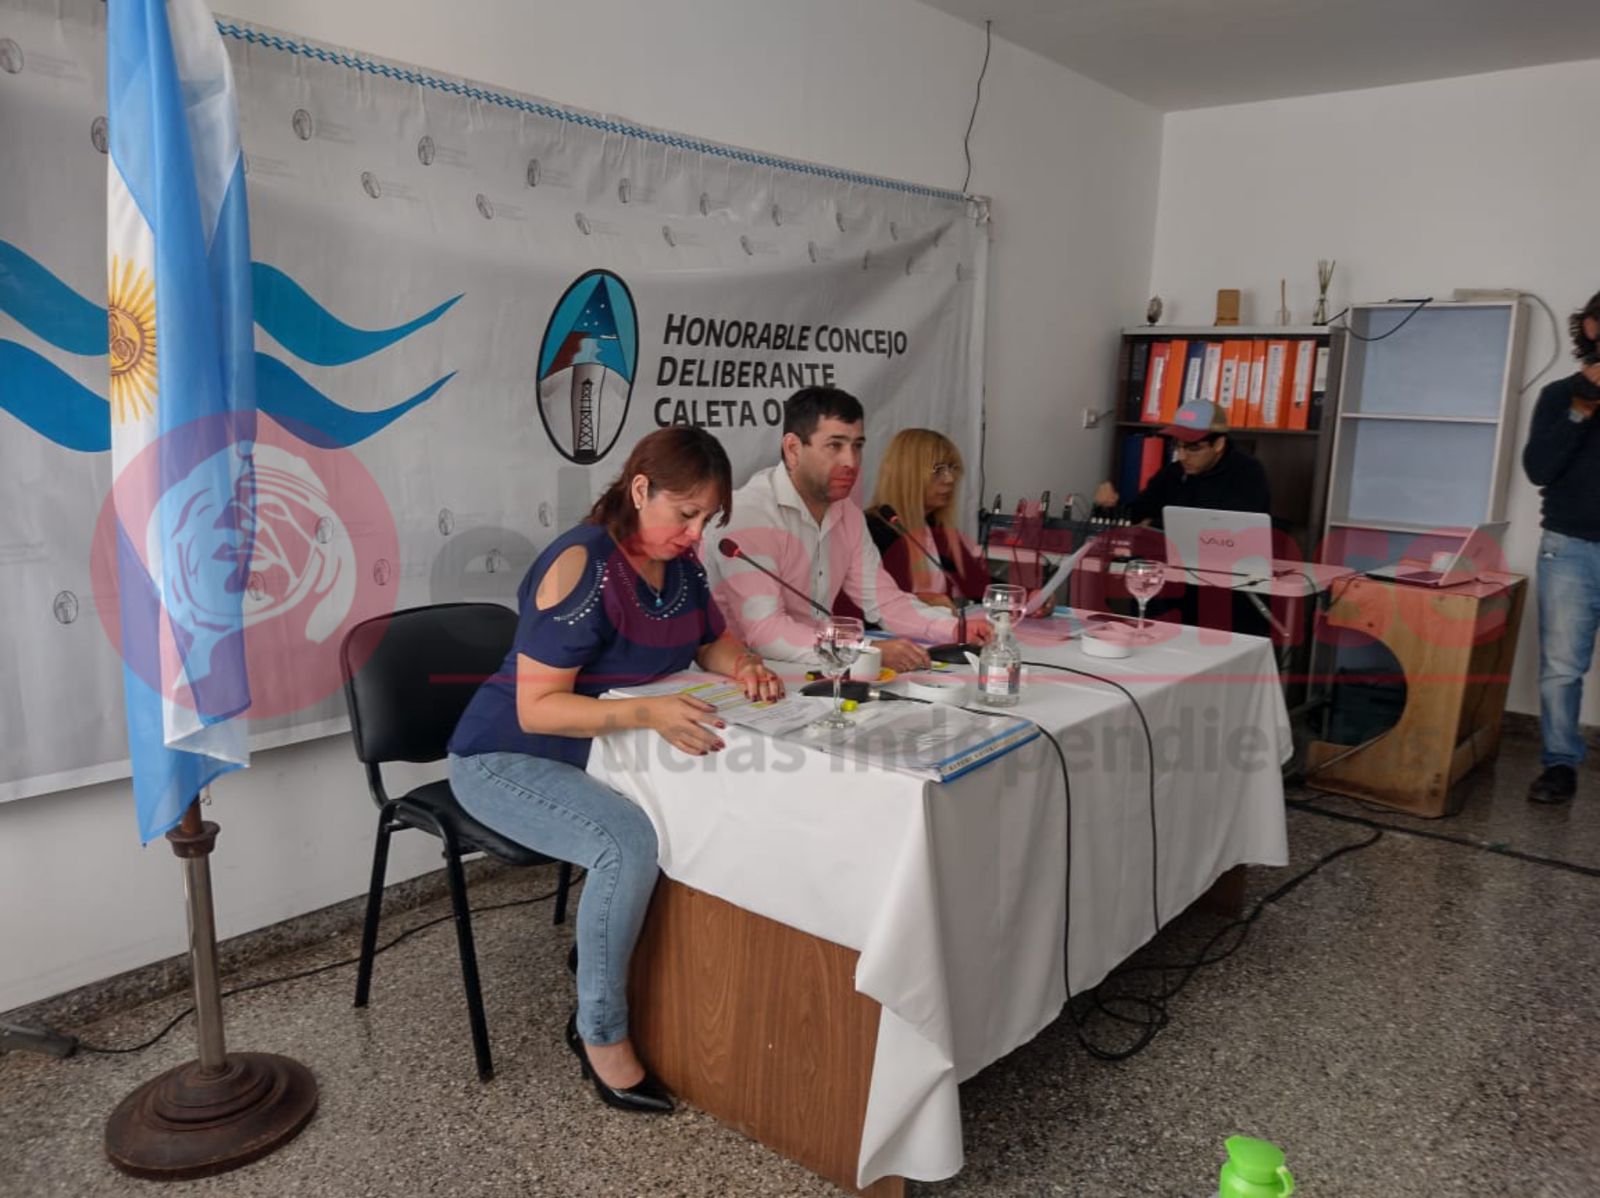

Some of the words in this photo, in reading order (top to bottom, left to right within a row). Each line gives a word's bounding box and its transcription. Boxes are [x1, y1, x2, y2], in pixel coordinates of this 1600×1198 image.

[663, 313, 811, 352] HONORABLE
[814, 324, 908, 359] CONCEJO
[656, 356, 837, 388] DELIBERANTE
[653, 397, 758, 428] CALETA
